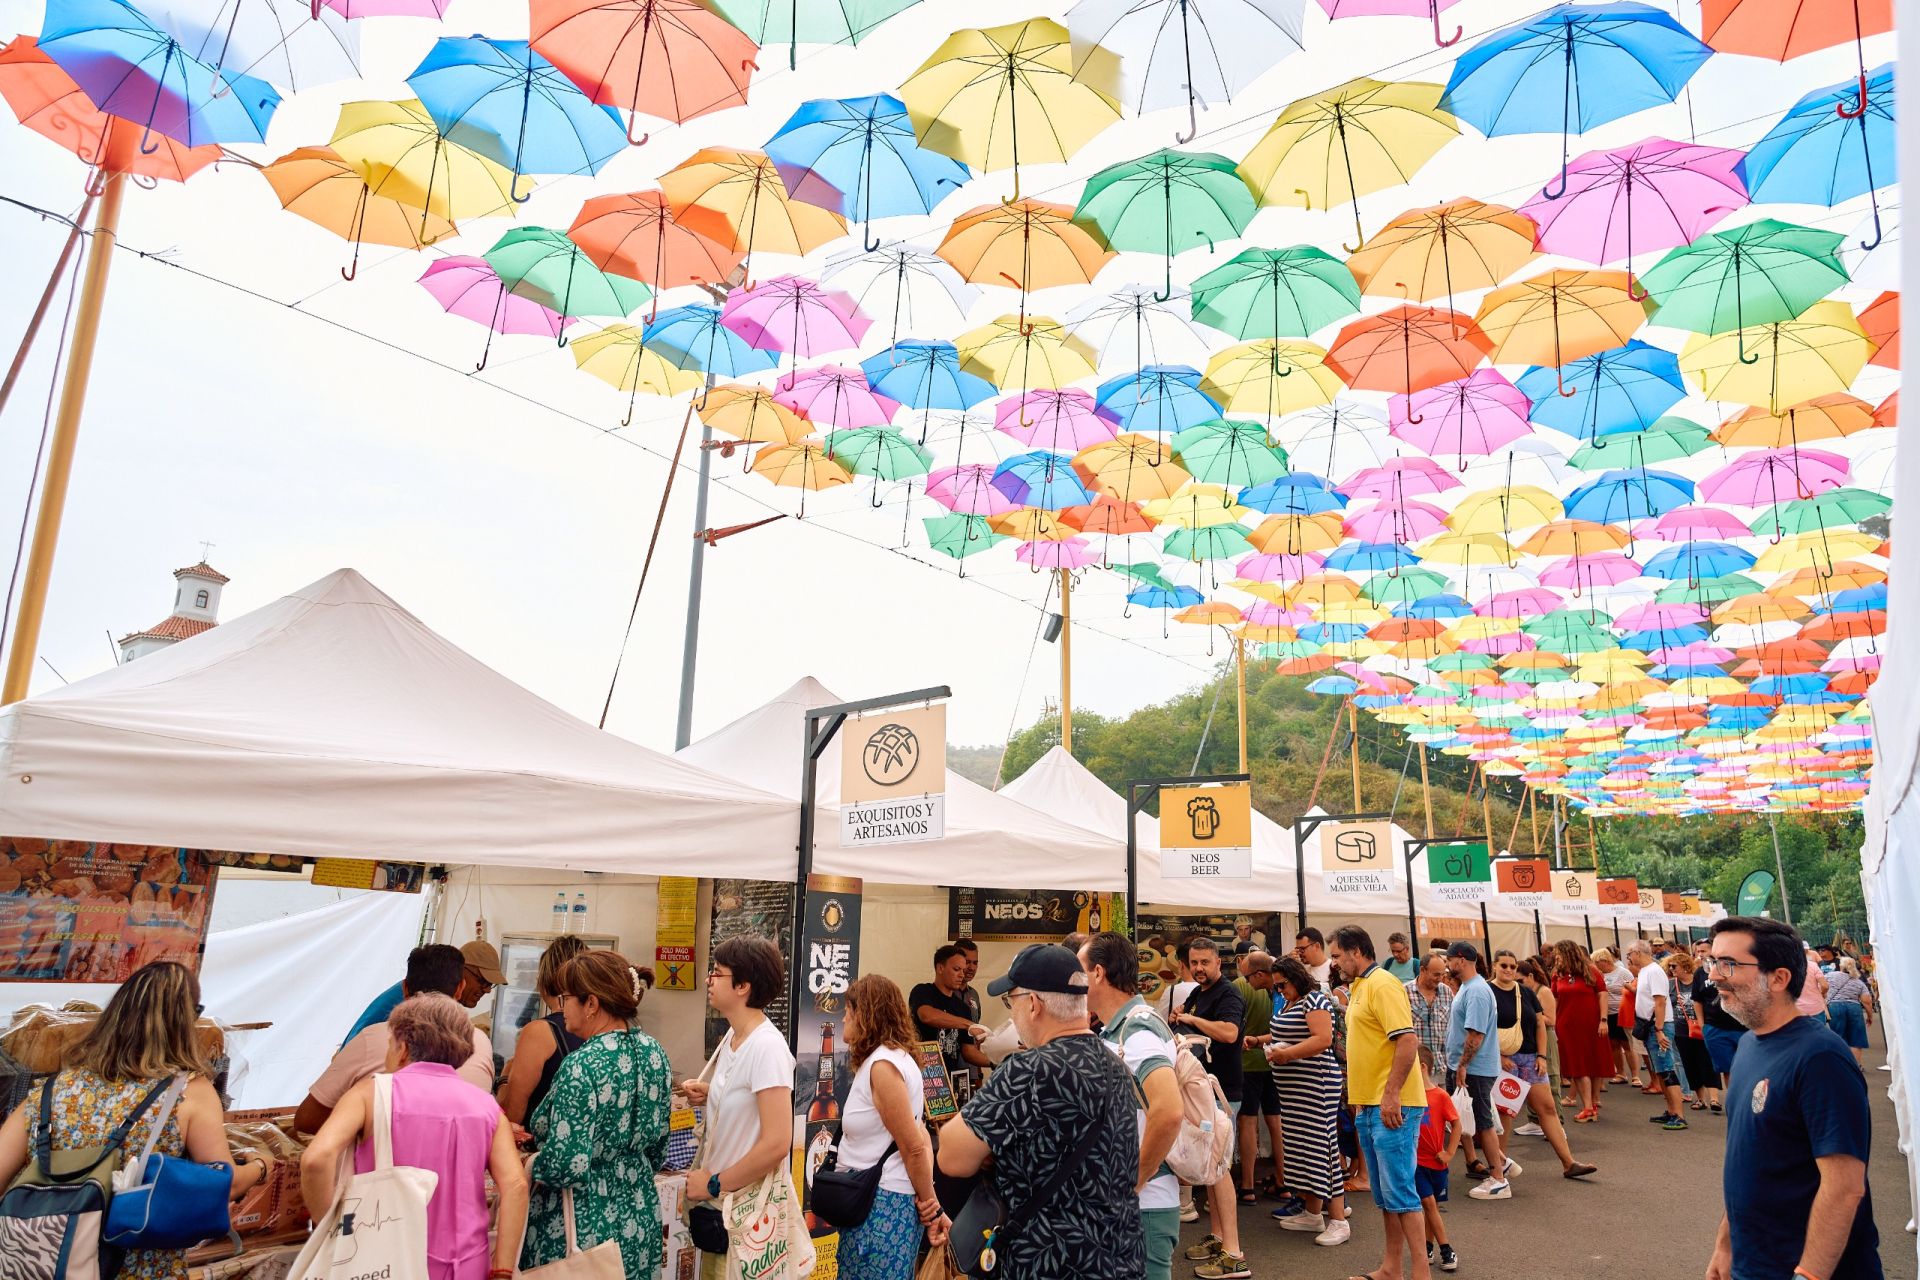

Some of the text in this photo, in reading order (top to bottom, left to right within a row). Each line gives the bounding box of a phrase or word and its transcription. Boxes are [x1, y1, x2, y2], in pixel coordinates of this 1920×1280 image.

[848, 803, 935, 825] EXQUISITOS Y
[853, 820, 928, 840] ARTESANOS
[1191, 853, 1220, 863] NEOS
[1191, 865, 1220, 875] BEER
[1336, 874, 1380, 884] QUESERÍA
[1330, 883, 1388, 892] MADRE VIEJA
[1438, 885, 1485, 894] ASOCIACIÓN
[985, 903, 1043, 919] NEOS
[1500, 1081, 1520, 1096] Trabel
[260, 1111, 281, 1119] papas
[737, 1203, 755, 1217] Hoy
